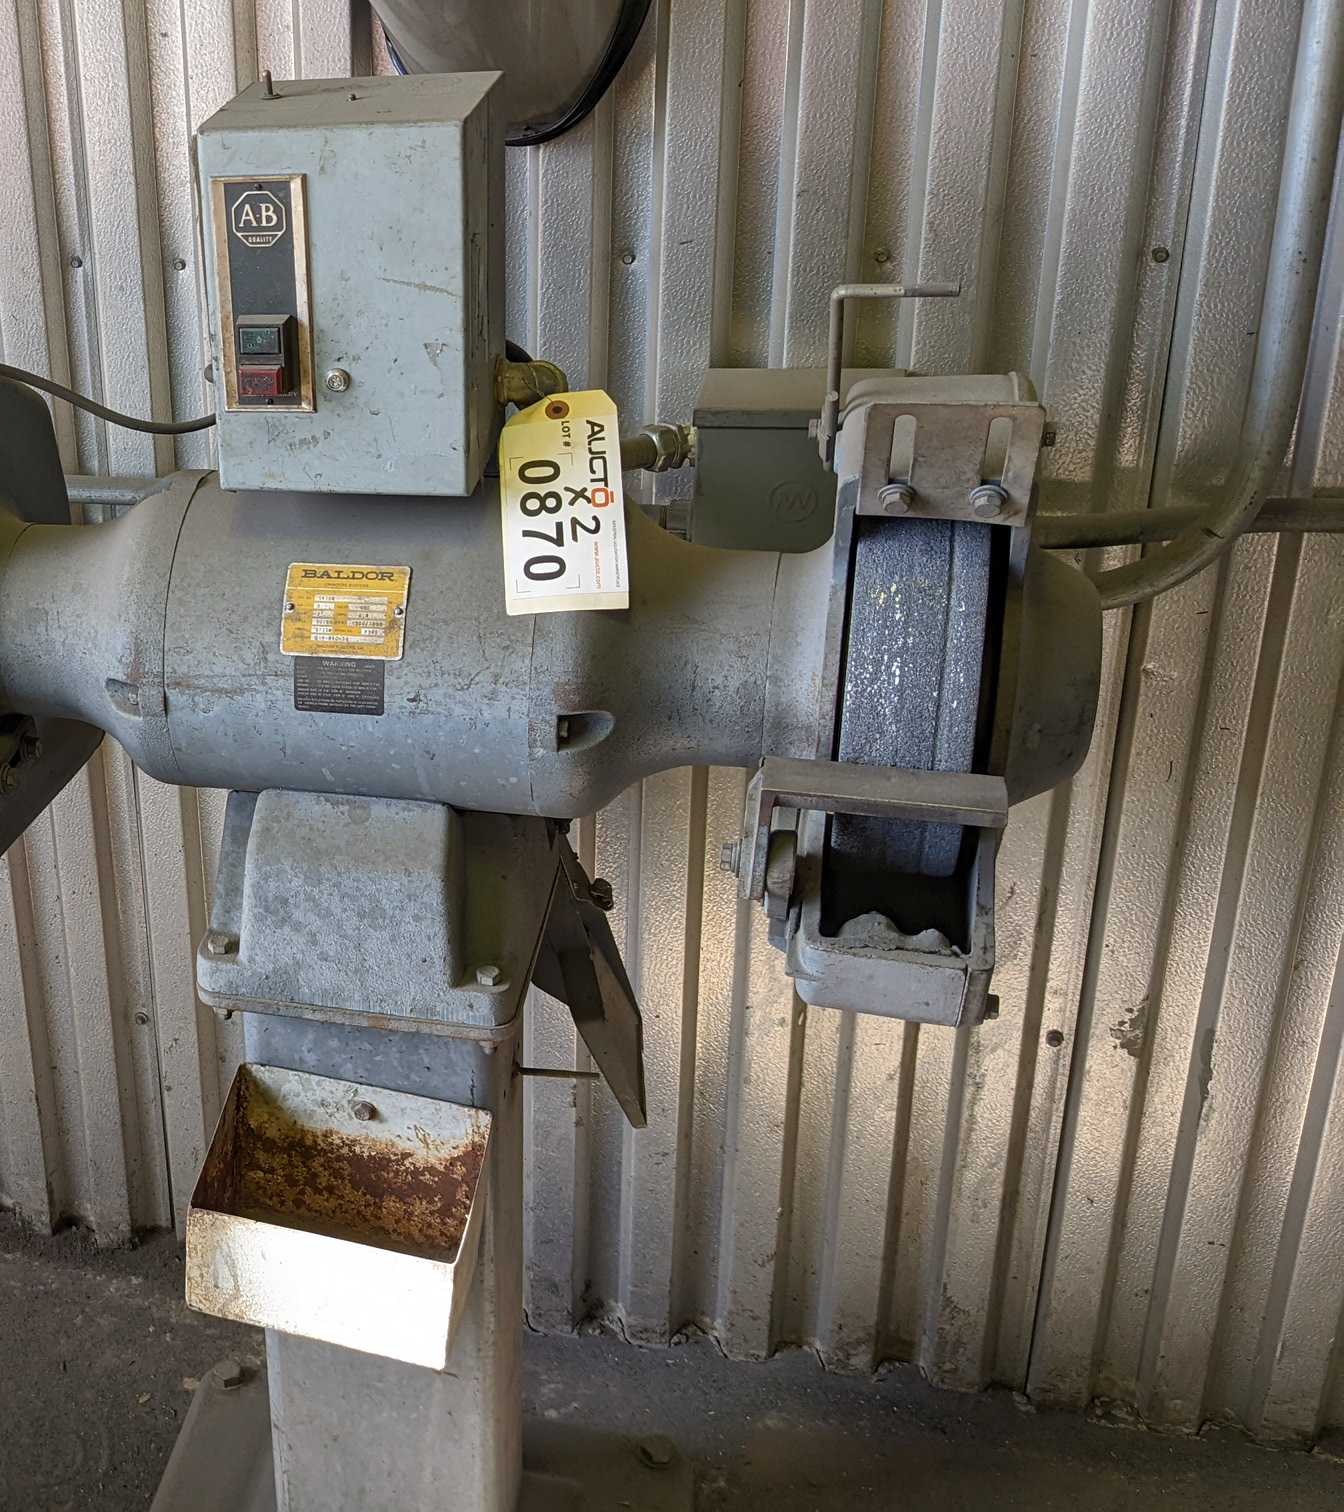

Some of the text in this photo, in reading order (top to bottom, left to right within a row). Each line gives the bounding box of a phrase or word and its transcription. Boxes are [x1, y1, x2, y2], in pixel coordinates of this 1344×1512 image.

[560, 420, 572, 438] LOT
[518, 459, 567, 581] 0870
[301, 568, 395, 582] BALDOR
